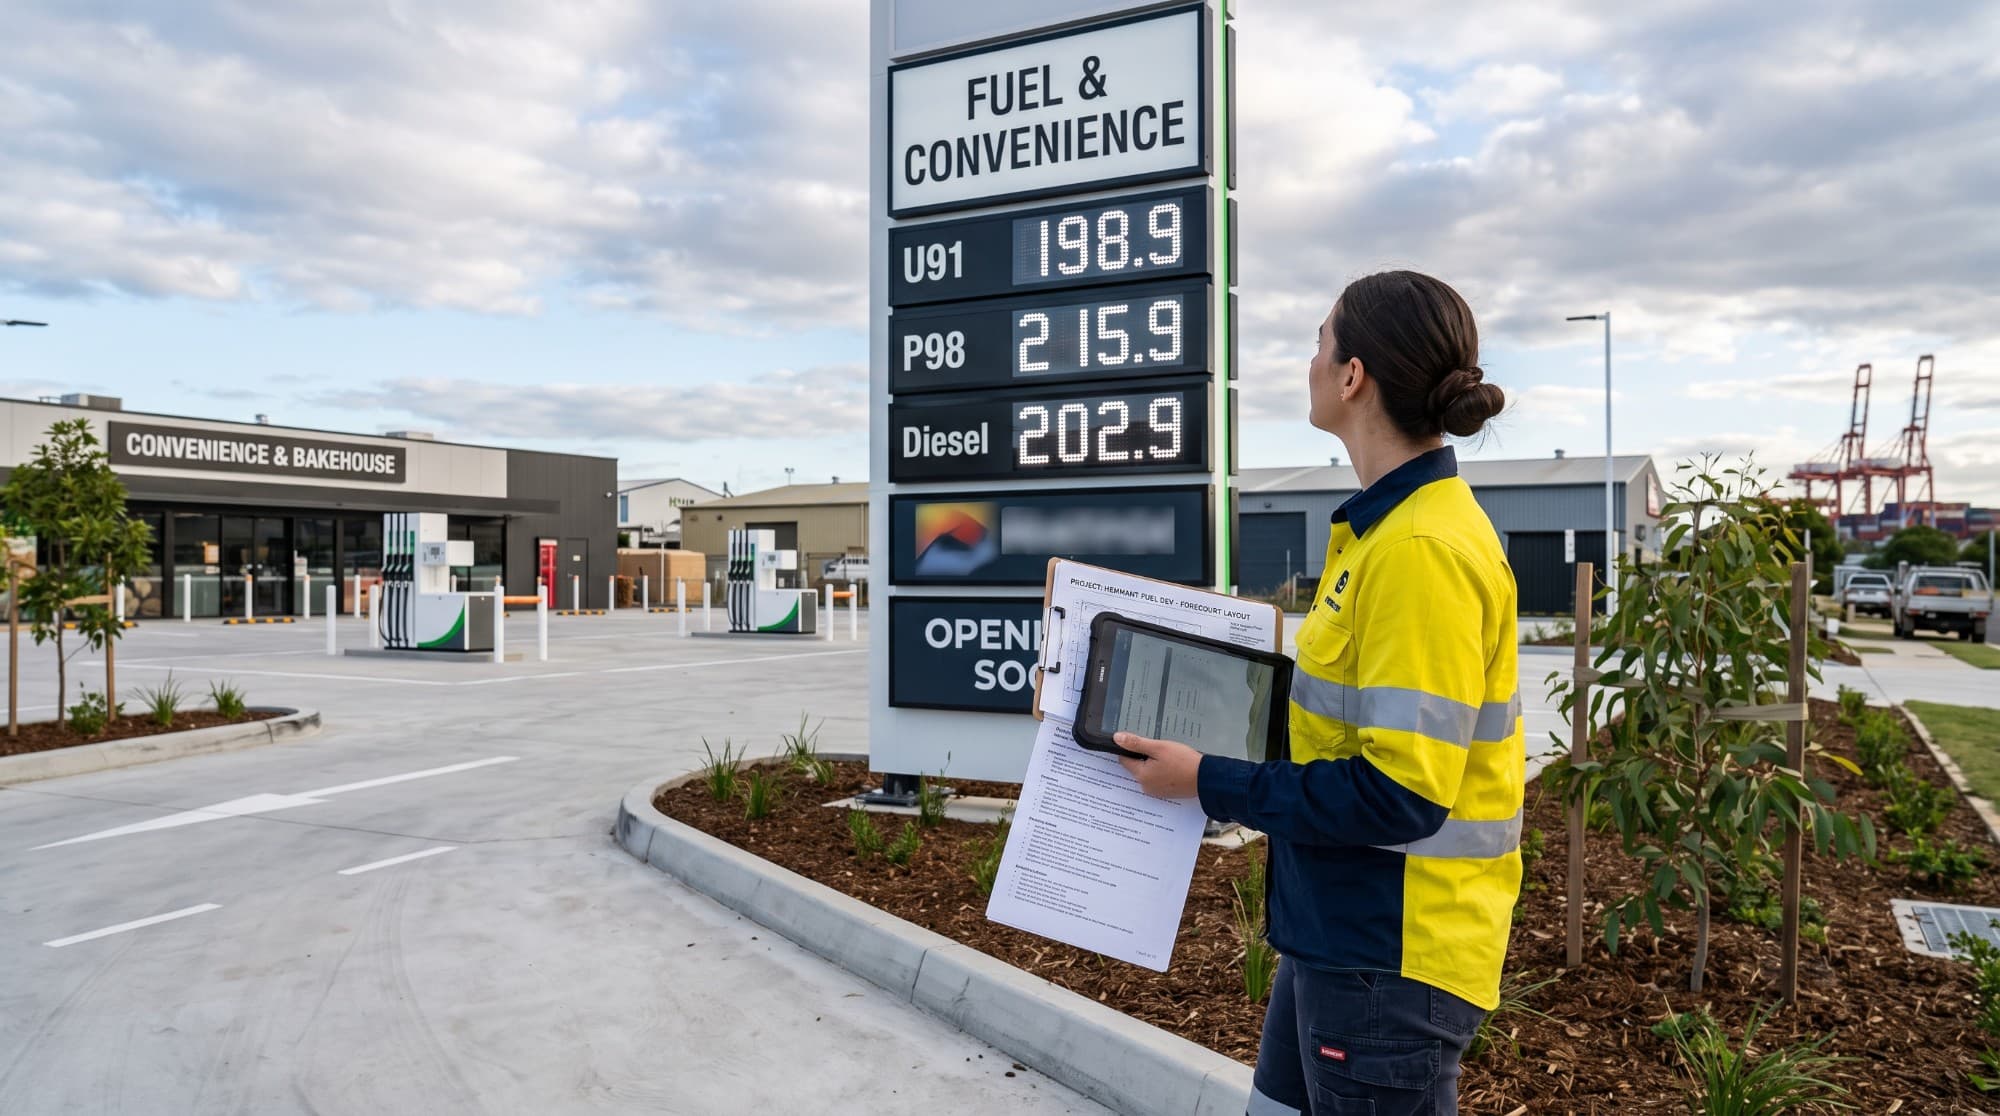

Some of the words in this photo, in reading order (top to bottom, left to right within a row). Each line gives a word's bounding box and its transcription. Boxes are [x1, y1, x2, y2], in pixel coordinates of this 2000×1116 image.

[968, 64, 1063, 120] FUEL
[1079, 56, 1107, 100] &
[905, 101, 1185, 186] CONVENIENCE
[904, 241, 962, 283] U91
[1041, 204, 1181, 277] 198.9
[904, 331, 965, 371] P98
[1019, 300, 1181, 372] 215.9
[126, 433, 269, 465] CONVENIENCE
[273, 445, 288, 467] &
[293, 447, 395, 475] BAKEHOUSE
[904, 422, 988, 458] Diesel
[1019, 397, 1181, 465] 202.9
[925, 618, 1041, 651] OPENI
[1104, 585, 1139, 598] HEMMANT
[1180, 601, 1222, 615] FORECOURT
[1223, 610, 1251, 620] LAYOUT
